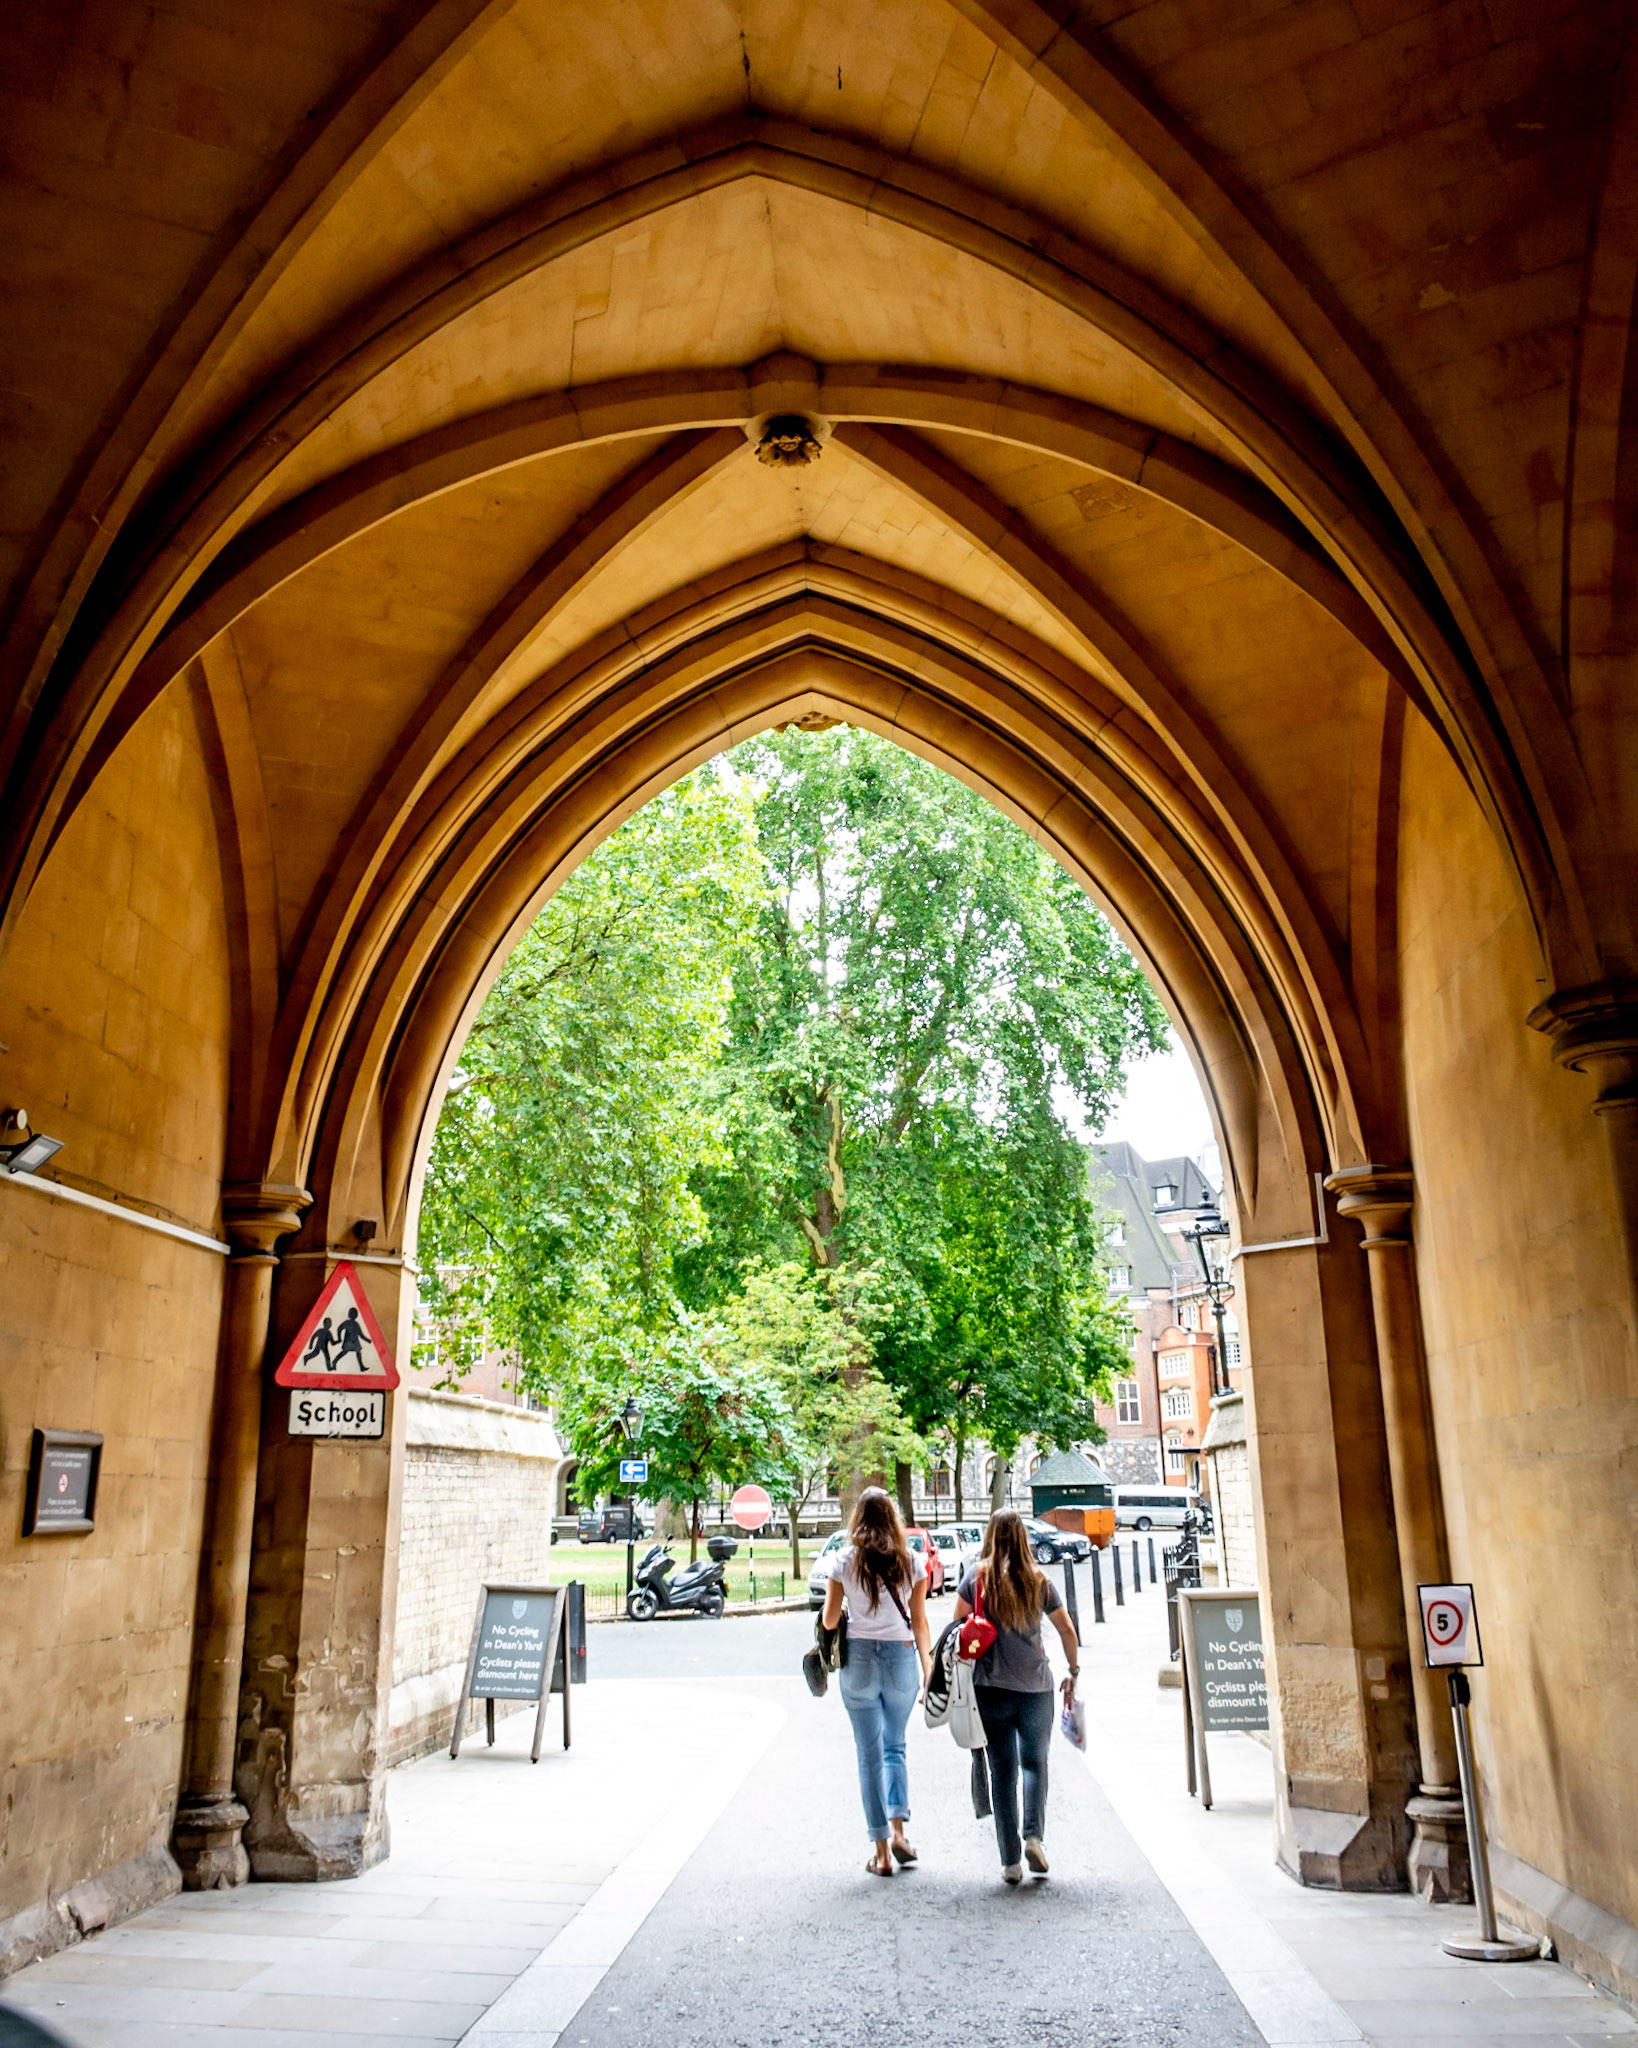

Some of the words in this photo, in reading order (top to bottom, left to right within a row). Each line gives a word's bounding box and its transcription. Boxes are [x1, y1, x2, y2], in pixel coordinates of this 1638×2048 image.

[297, 1401, 376, 1423] School
[1437, 1613, 1449, 1632] 5
[492, 1625, 506, 1635] No
[508, 1625, 539, 1638] Cycling
[484, 1640, 492, 1649] in
[494, 1639, 522, 1650] Dean's
[524, 1640, 543, 1651] Yard
[1208, 1641, 1226, 1653] No
[479, 1656, 512, 1668] Cyclists
[513, 1659, 541, 1670] please
[1204, 1660, 1215, 1671] in
[1217, 1658, 1252, 1671] Dean's
[477, 1669, 517, 1680] dismount
[518, 1670, 539, 1680] here
[1205, 1682, 1246, 1696] Cyclists
[1207, 1697, 1257, 1708] dismount
